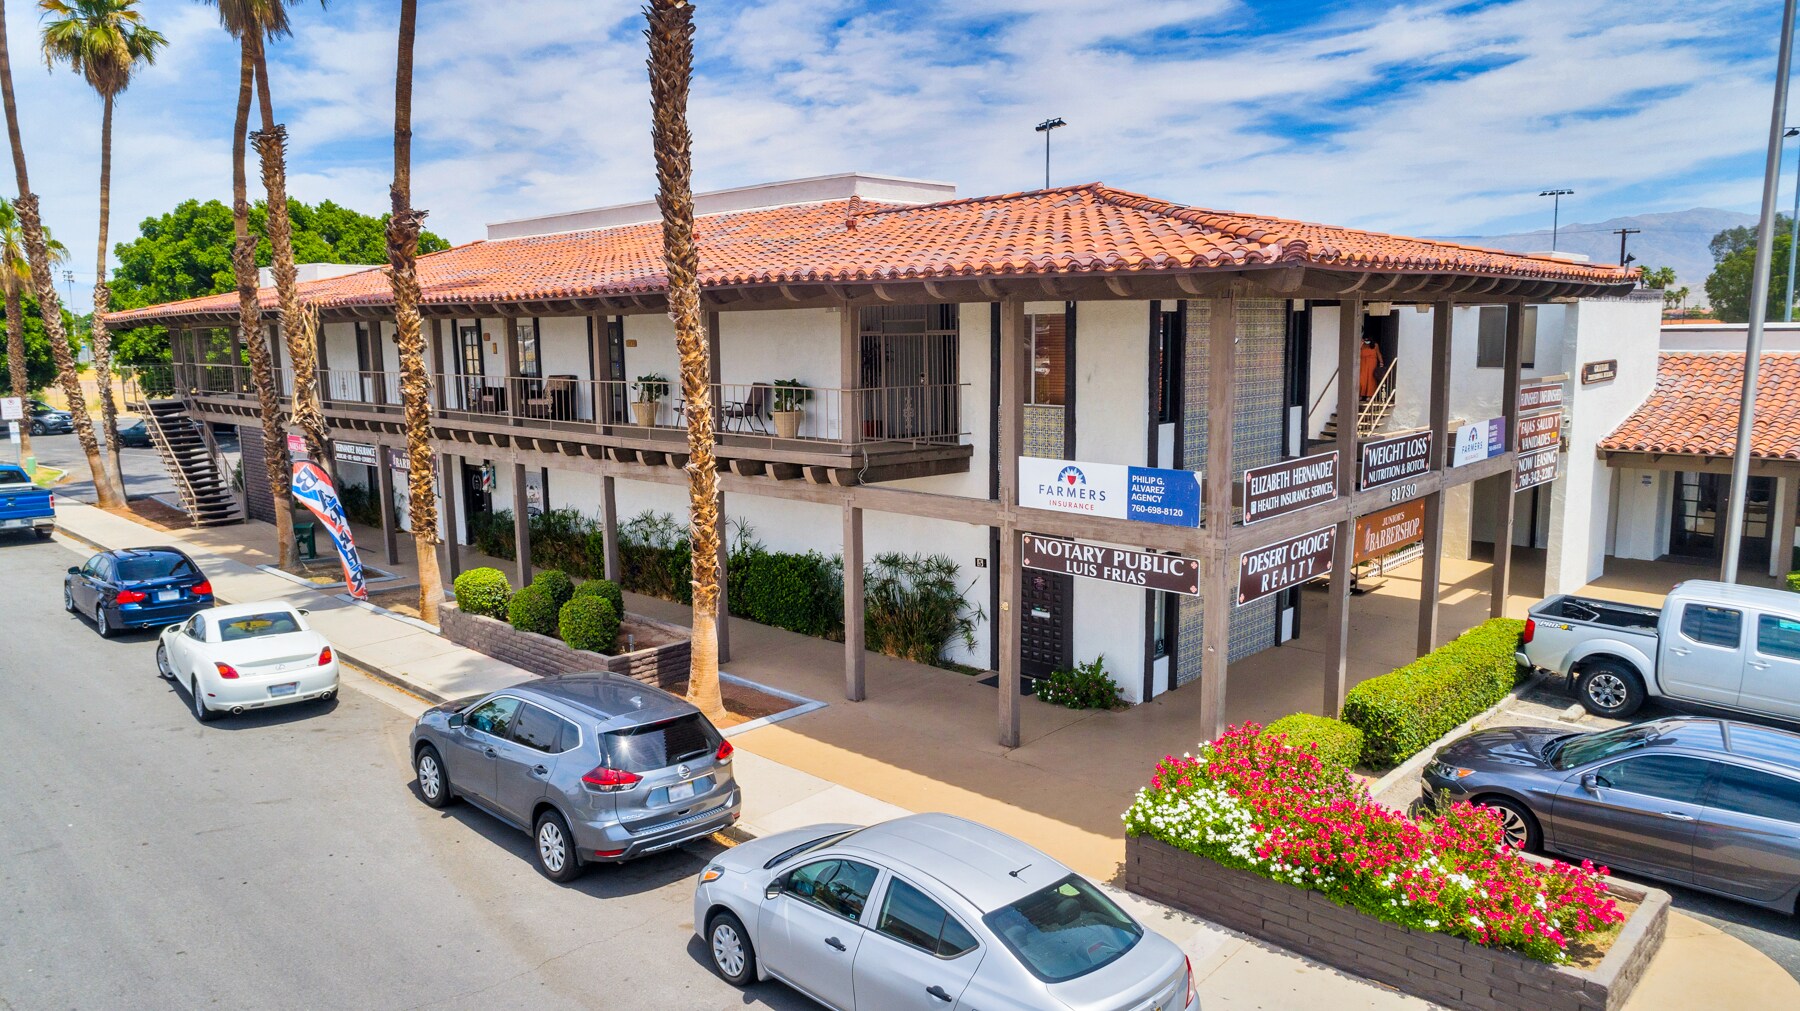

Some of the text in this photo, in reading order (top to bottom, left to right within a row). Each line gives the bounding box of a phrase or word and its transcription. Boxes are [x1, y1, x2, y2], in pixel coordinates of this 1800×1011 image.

[1369, 437, 1428, 467] WEIGHT LOSS
[1462, 441, 1483, 454] FARMERS
[1518, 451, 1556, 473] NOW LEASING
[1132, 475, 1165, 486] PHILIP G.
[1251, 460, 1334, 496] ELIZABETH HERNANDEZ
[1368, 465, 1401, 484] NUTRITION
[1400, 464, 1406, 475] &
[1038, 484, 1106, 502] FARMERS
[1132, 484, 1165, 495] ALVAREZ
[1132, 494, 1162, 504] AGENCY
[1257, 481, 1334, 512] HEALTH INSURANCE SERVICES
[1391, 484, 1416, 502] 81730
[1049, 500, 1095, 511] INSURANCE
[1132, 504, 1184, 517] 760-698-8120
[1368, 518, 1420, 552] BARBERSHOP
[1034, 538, 1184, 576] NOTARY PUBLIC
[1248, 532, 1329, 575] DESERT CHOICE
[1066, 560, 1146, 585] LUIS FRIAS
[1261, 557, 1315, 593] REALTY
